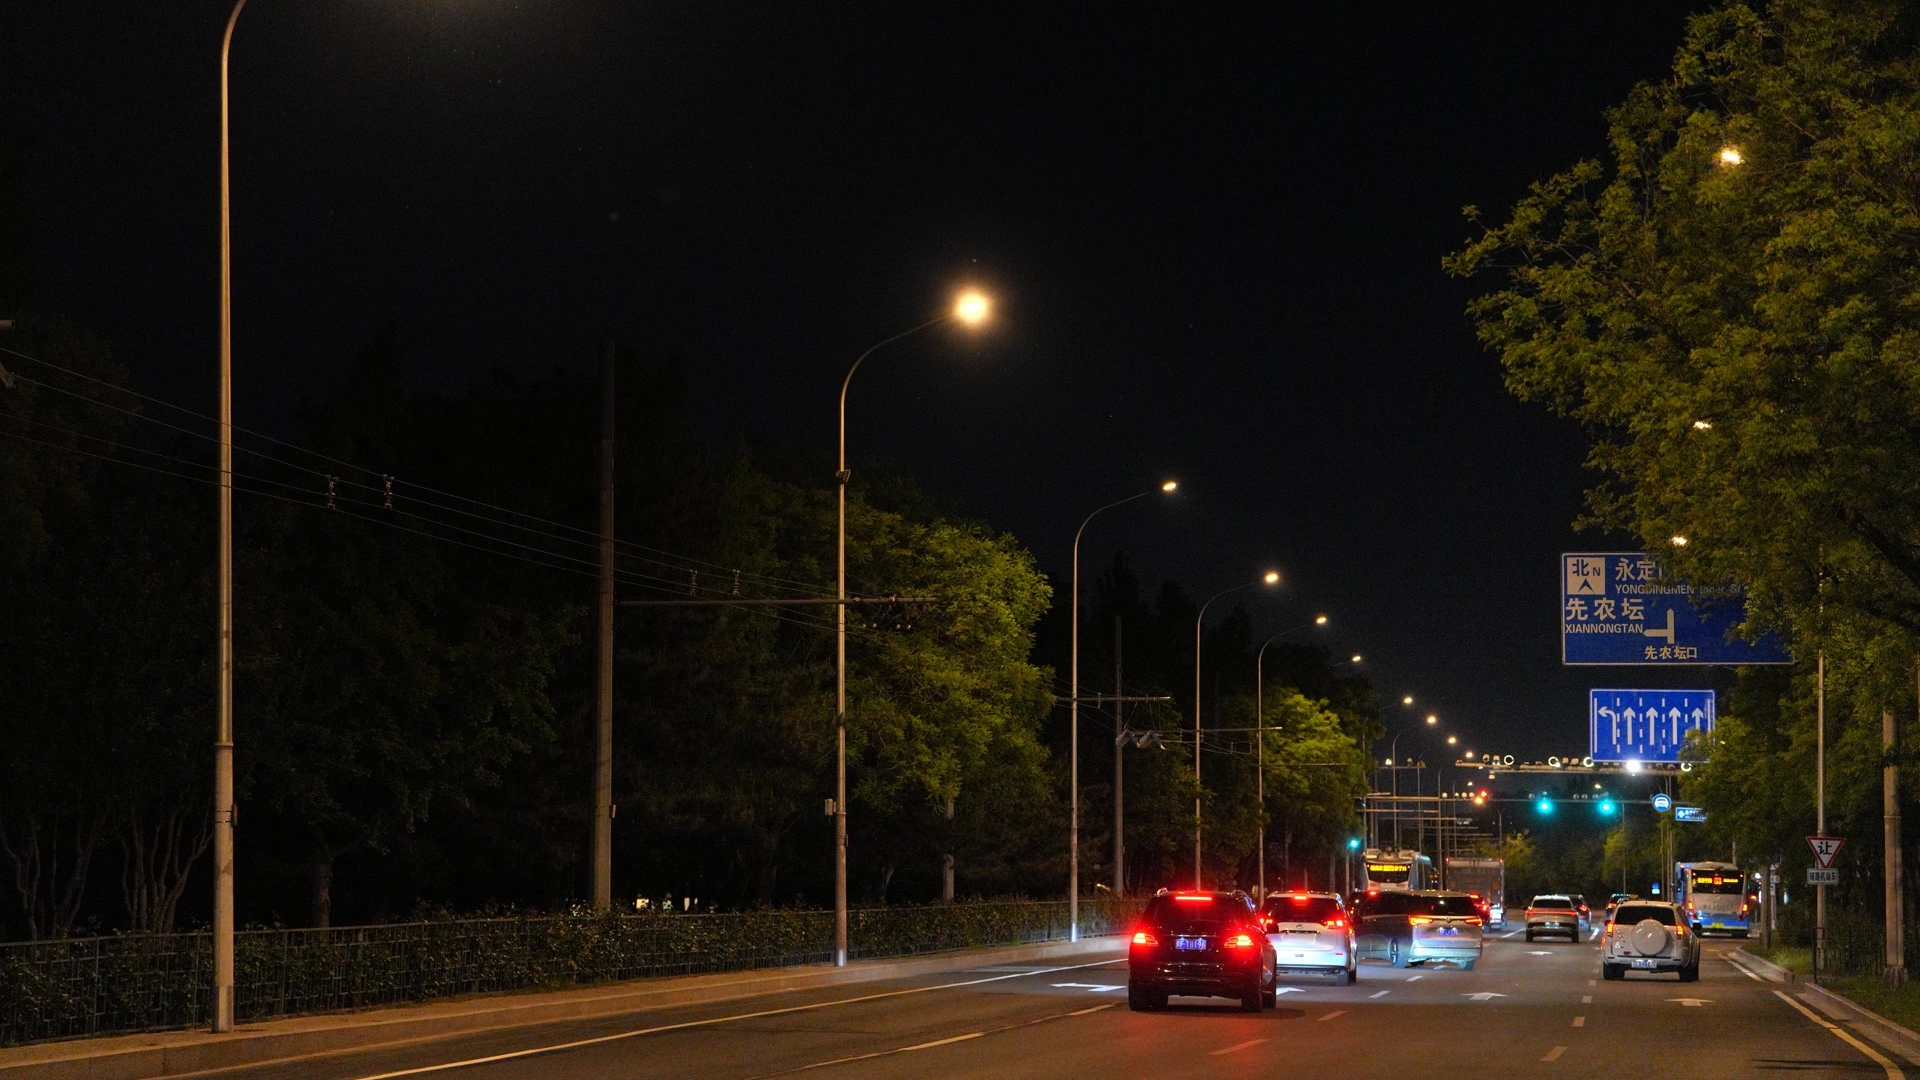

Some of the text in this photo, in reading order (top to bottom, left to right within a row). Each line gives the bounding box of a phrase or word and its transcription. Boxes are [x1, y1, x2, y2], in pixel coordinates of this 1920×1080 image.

[1572, 559, 1590, 577] 北
[1592, 566, 1601, 576] N
[1615, 558, 1663, 581] 永定
[1565, 597, 1645, 621] 先农坛
[1565, 623, 1643, 634] XIANNONGTAN
[1644, 645, 1697, 660] 先农坛口
[1818, 841, 1832, 855] 让
